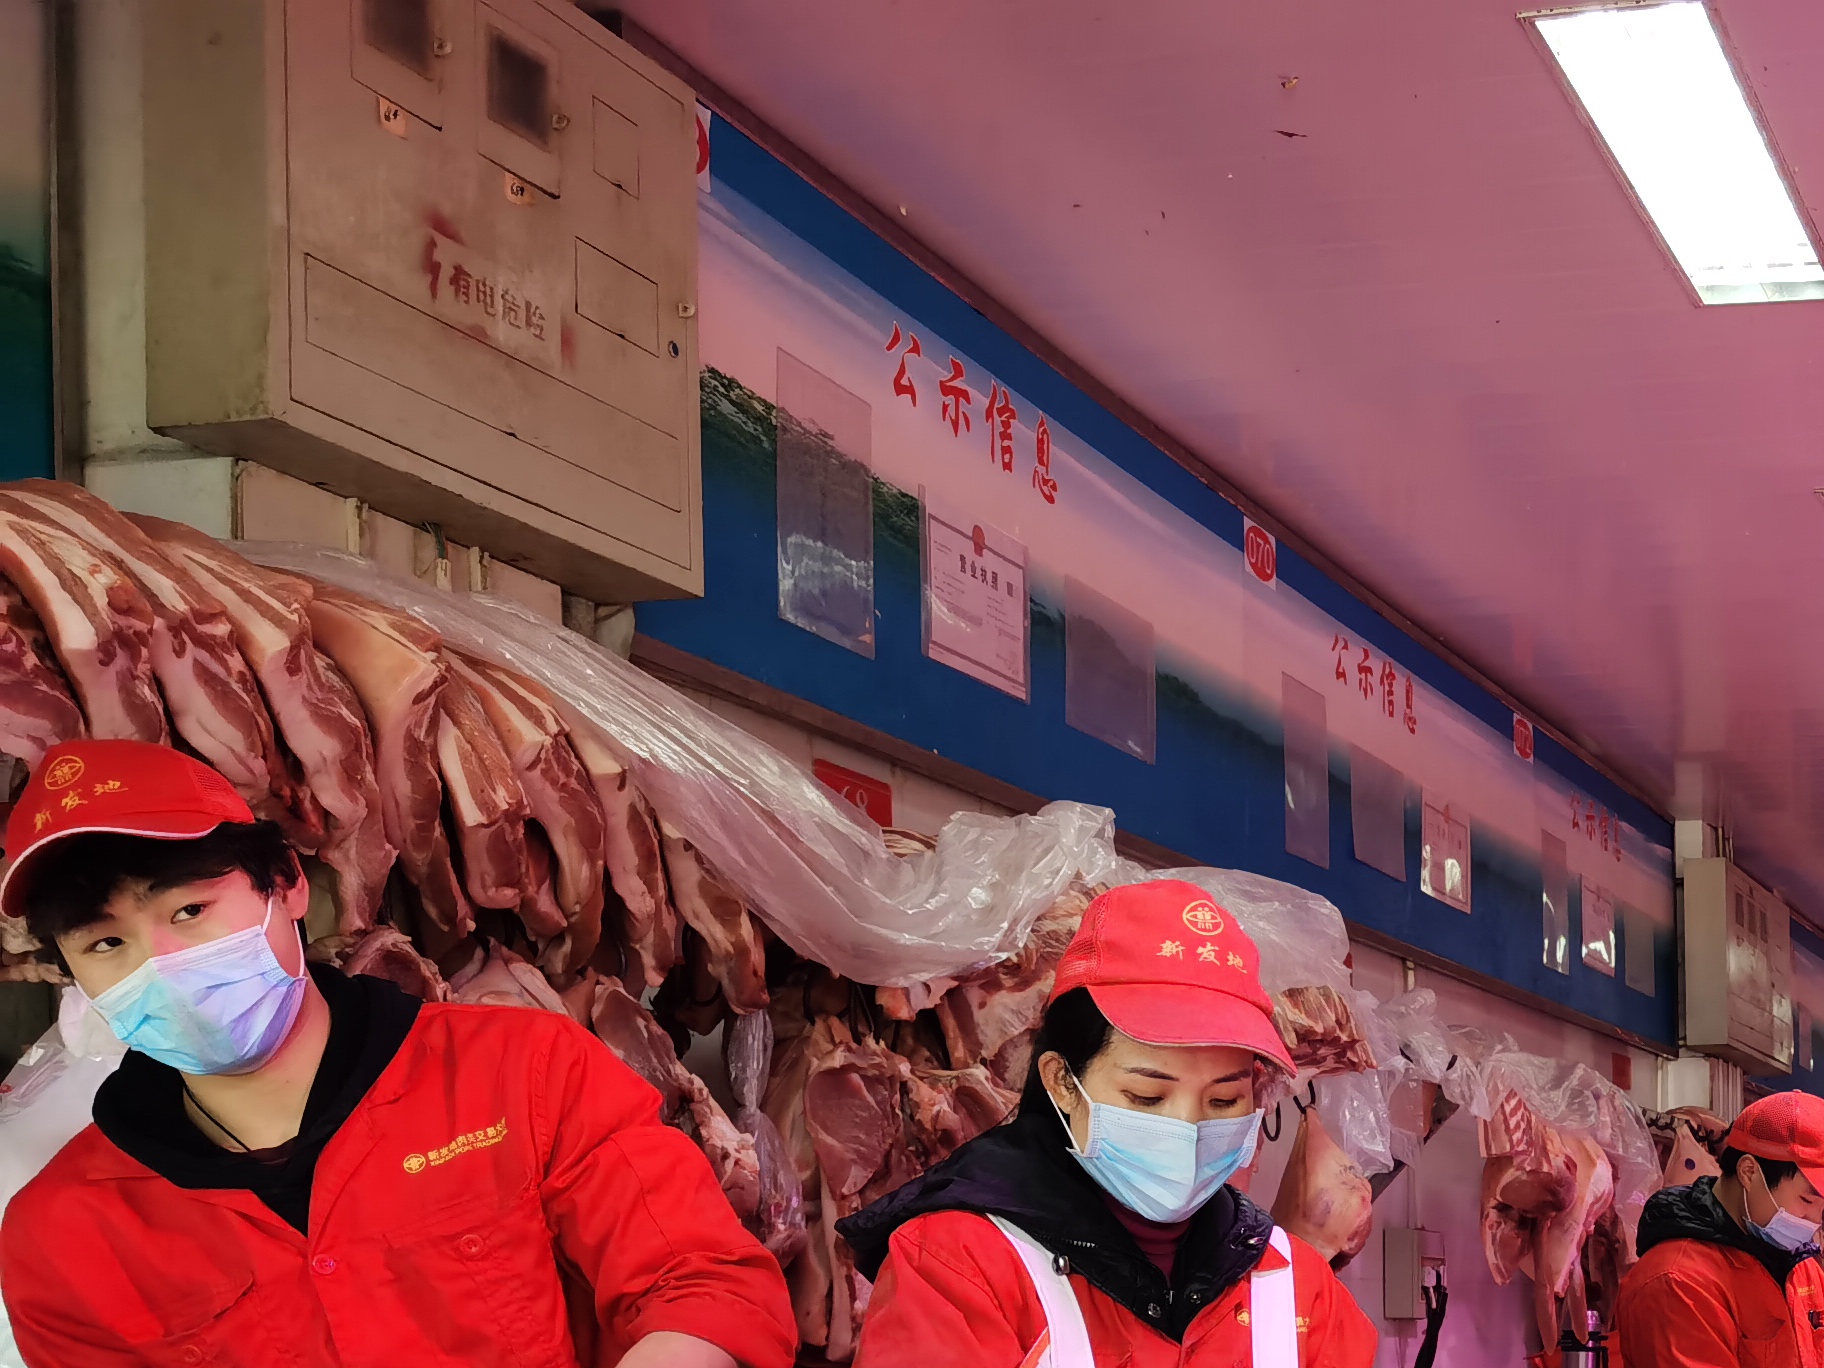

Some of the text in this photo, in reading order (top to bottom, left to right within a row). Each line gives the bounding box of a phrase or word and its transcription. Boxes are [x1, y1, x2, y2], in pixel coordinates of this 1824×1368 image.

[449, 264, 546, 342] 有电危险
[885, 321, 1058, 504] 公示信息
[1249, 532, 1272, 574] 070
[1331, 634, 1417, 735] 公示信息
[34, 779, 129, 834] 新发地
[1569, 790, 1622, 862] 公示信息
[1156, 940, 1247, 974] 新发地
